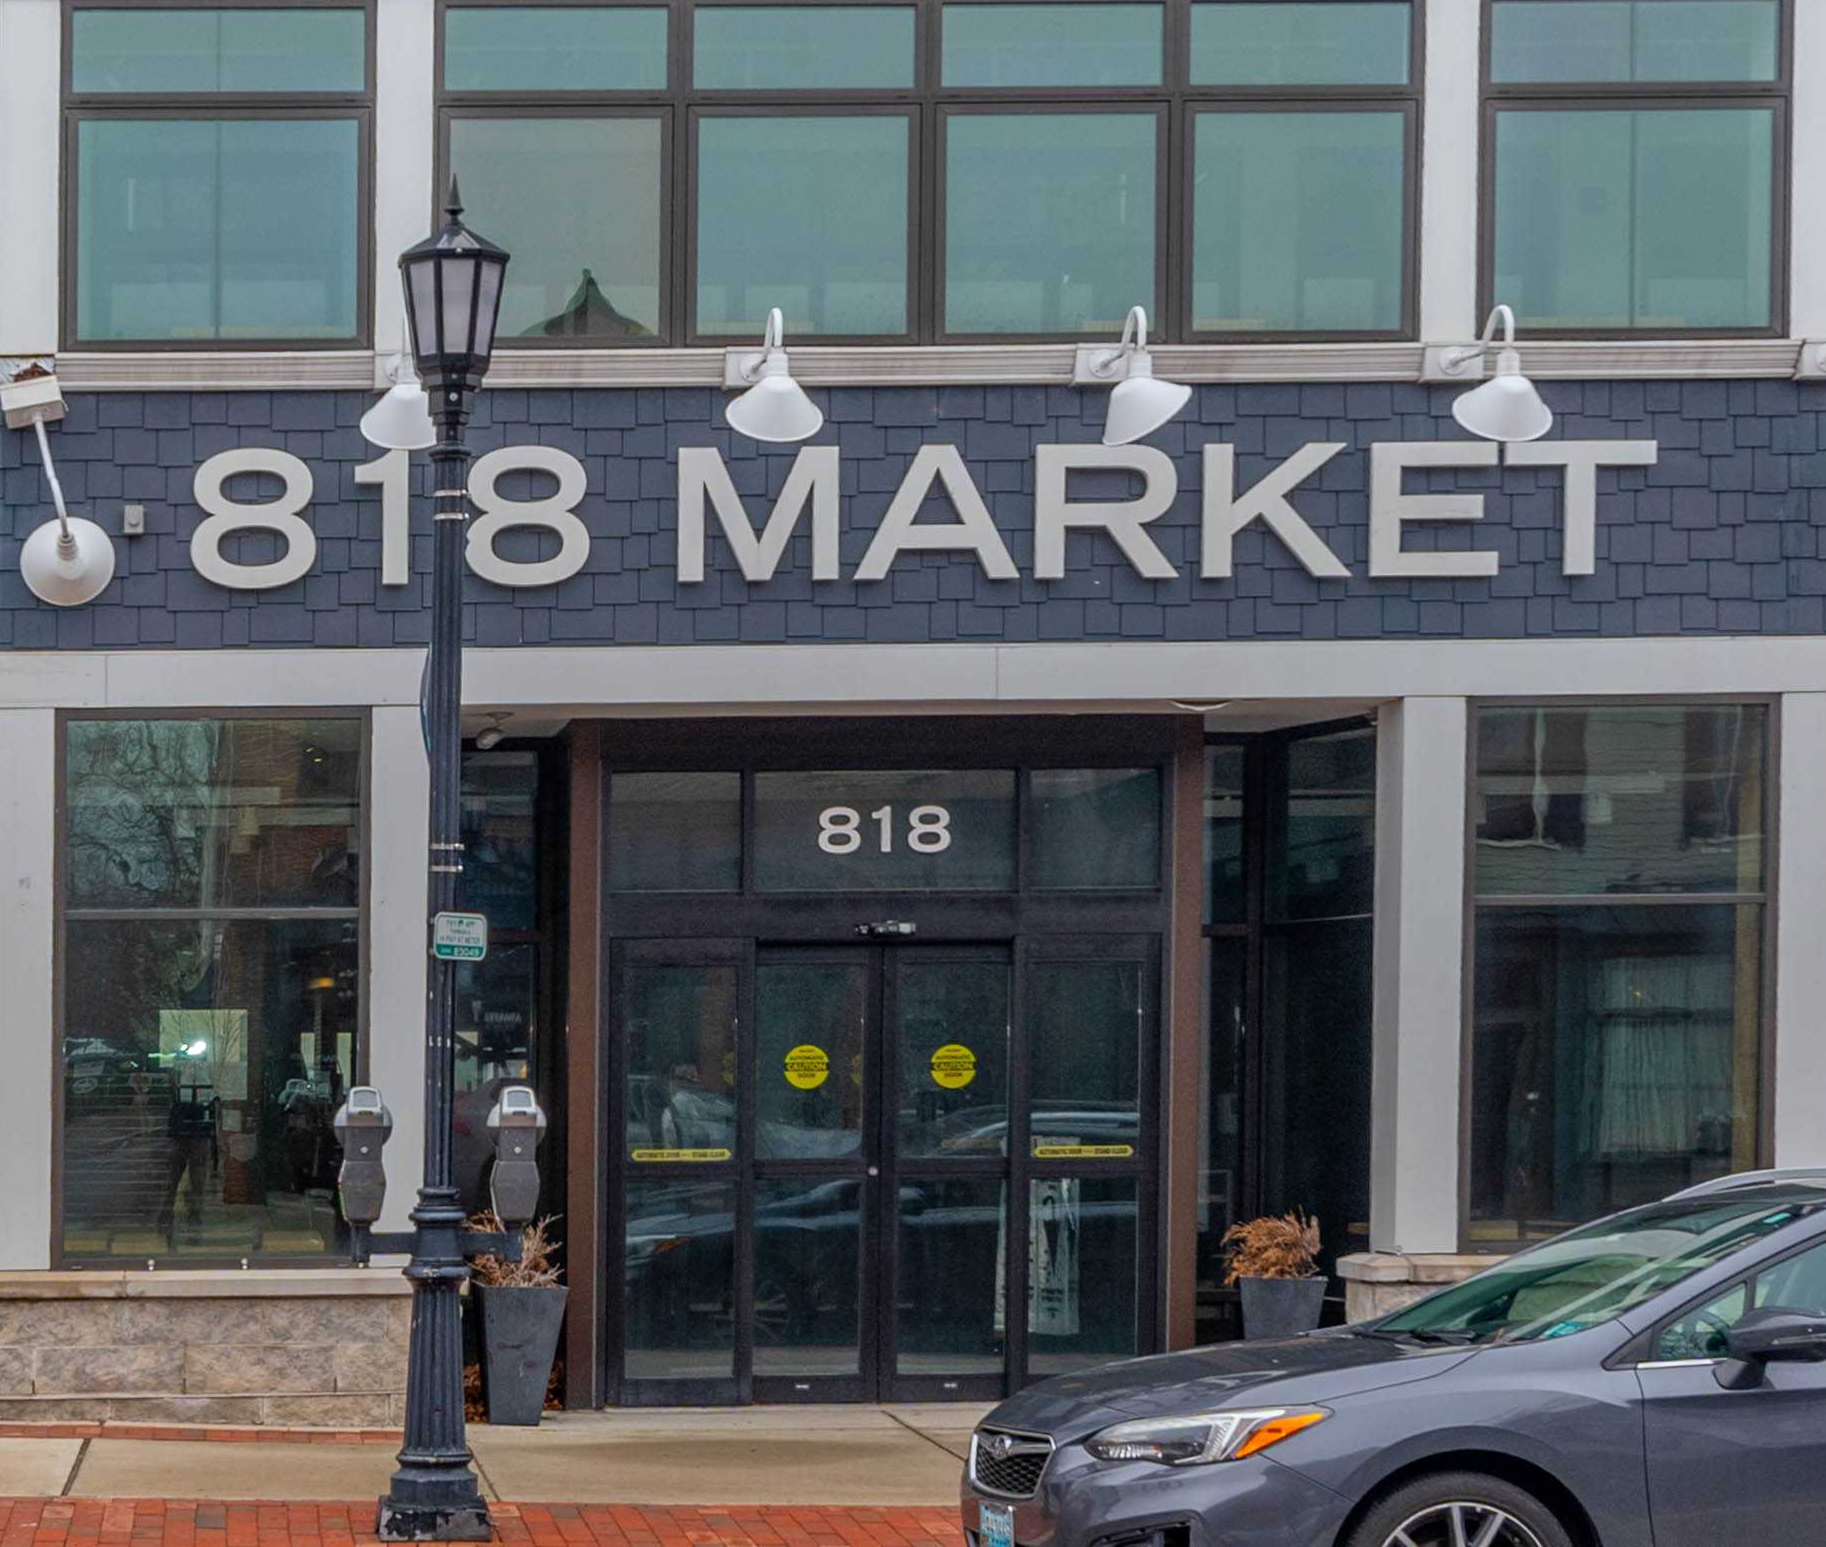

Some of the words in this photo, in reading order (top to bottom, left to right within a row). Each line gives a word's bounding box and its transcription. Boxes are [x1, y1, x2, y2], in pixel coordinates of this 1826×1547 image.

[191, 444, 591, 588] 818
[677, 439, 1658, 585] MARKET
[818, 804, 952, 854] 818
[786, 1062, 827, 1070] CAUTION
[933, 1061, 974, 1070] CAUTION
